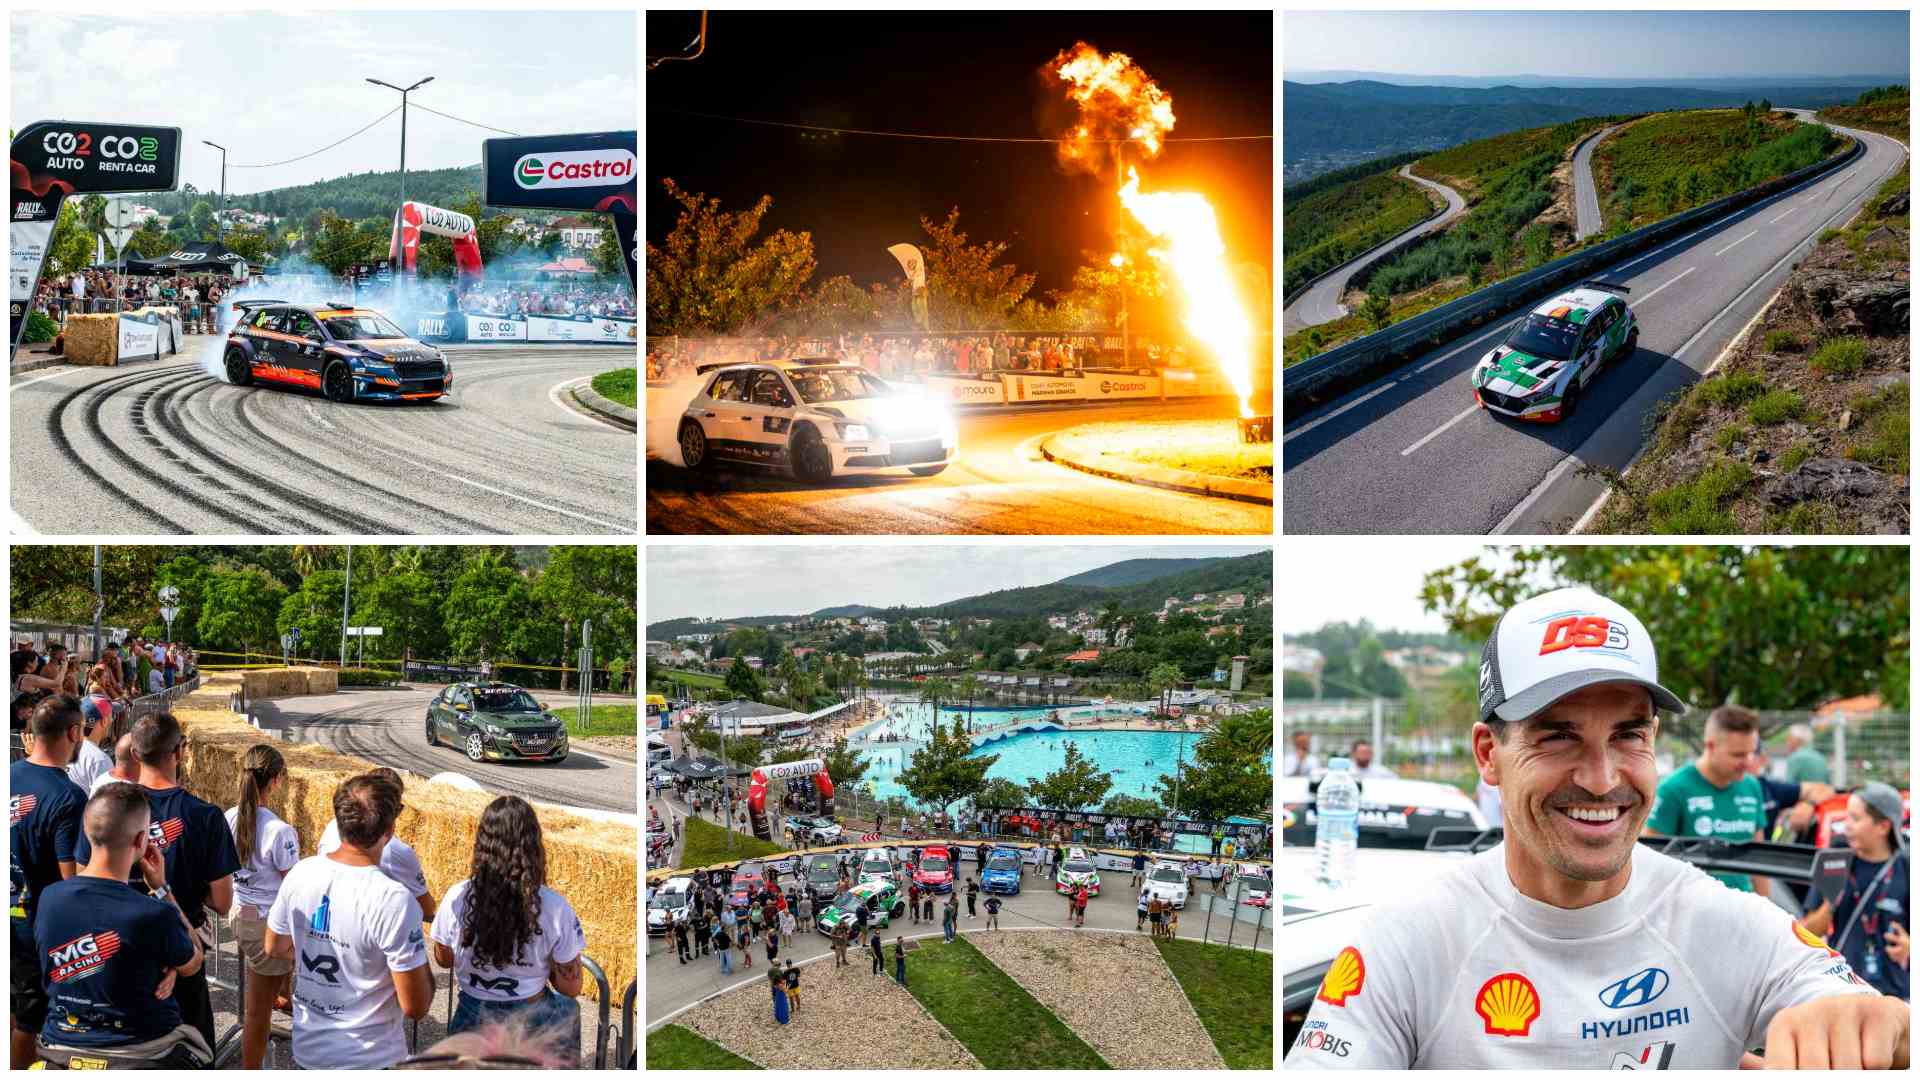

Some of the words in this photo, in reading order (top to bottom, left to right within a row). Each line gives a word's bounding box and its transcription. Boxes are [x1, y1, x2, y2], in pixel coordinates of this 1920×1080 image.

[43, 131, 92, 156] CO2
[99, 135, 159, 161] CO2
[46, 157, 85, 170] AUTO
[548, 158, 632, 180] Castrol
[1112, 381, 1147, 391] Castrol
[49, 935, 98, 966] MG
[60, 955, 102, 977] RACING
[1582, 1007, 1690, 1040] HYUNDAI
[1296, 1029, 1353, 1058] MOBIS
